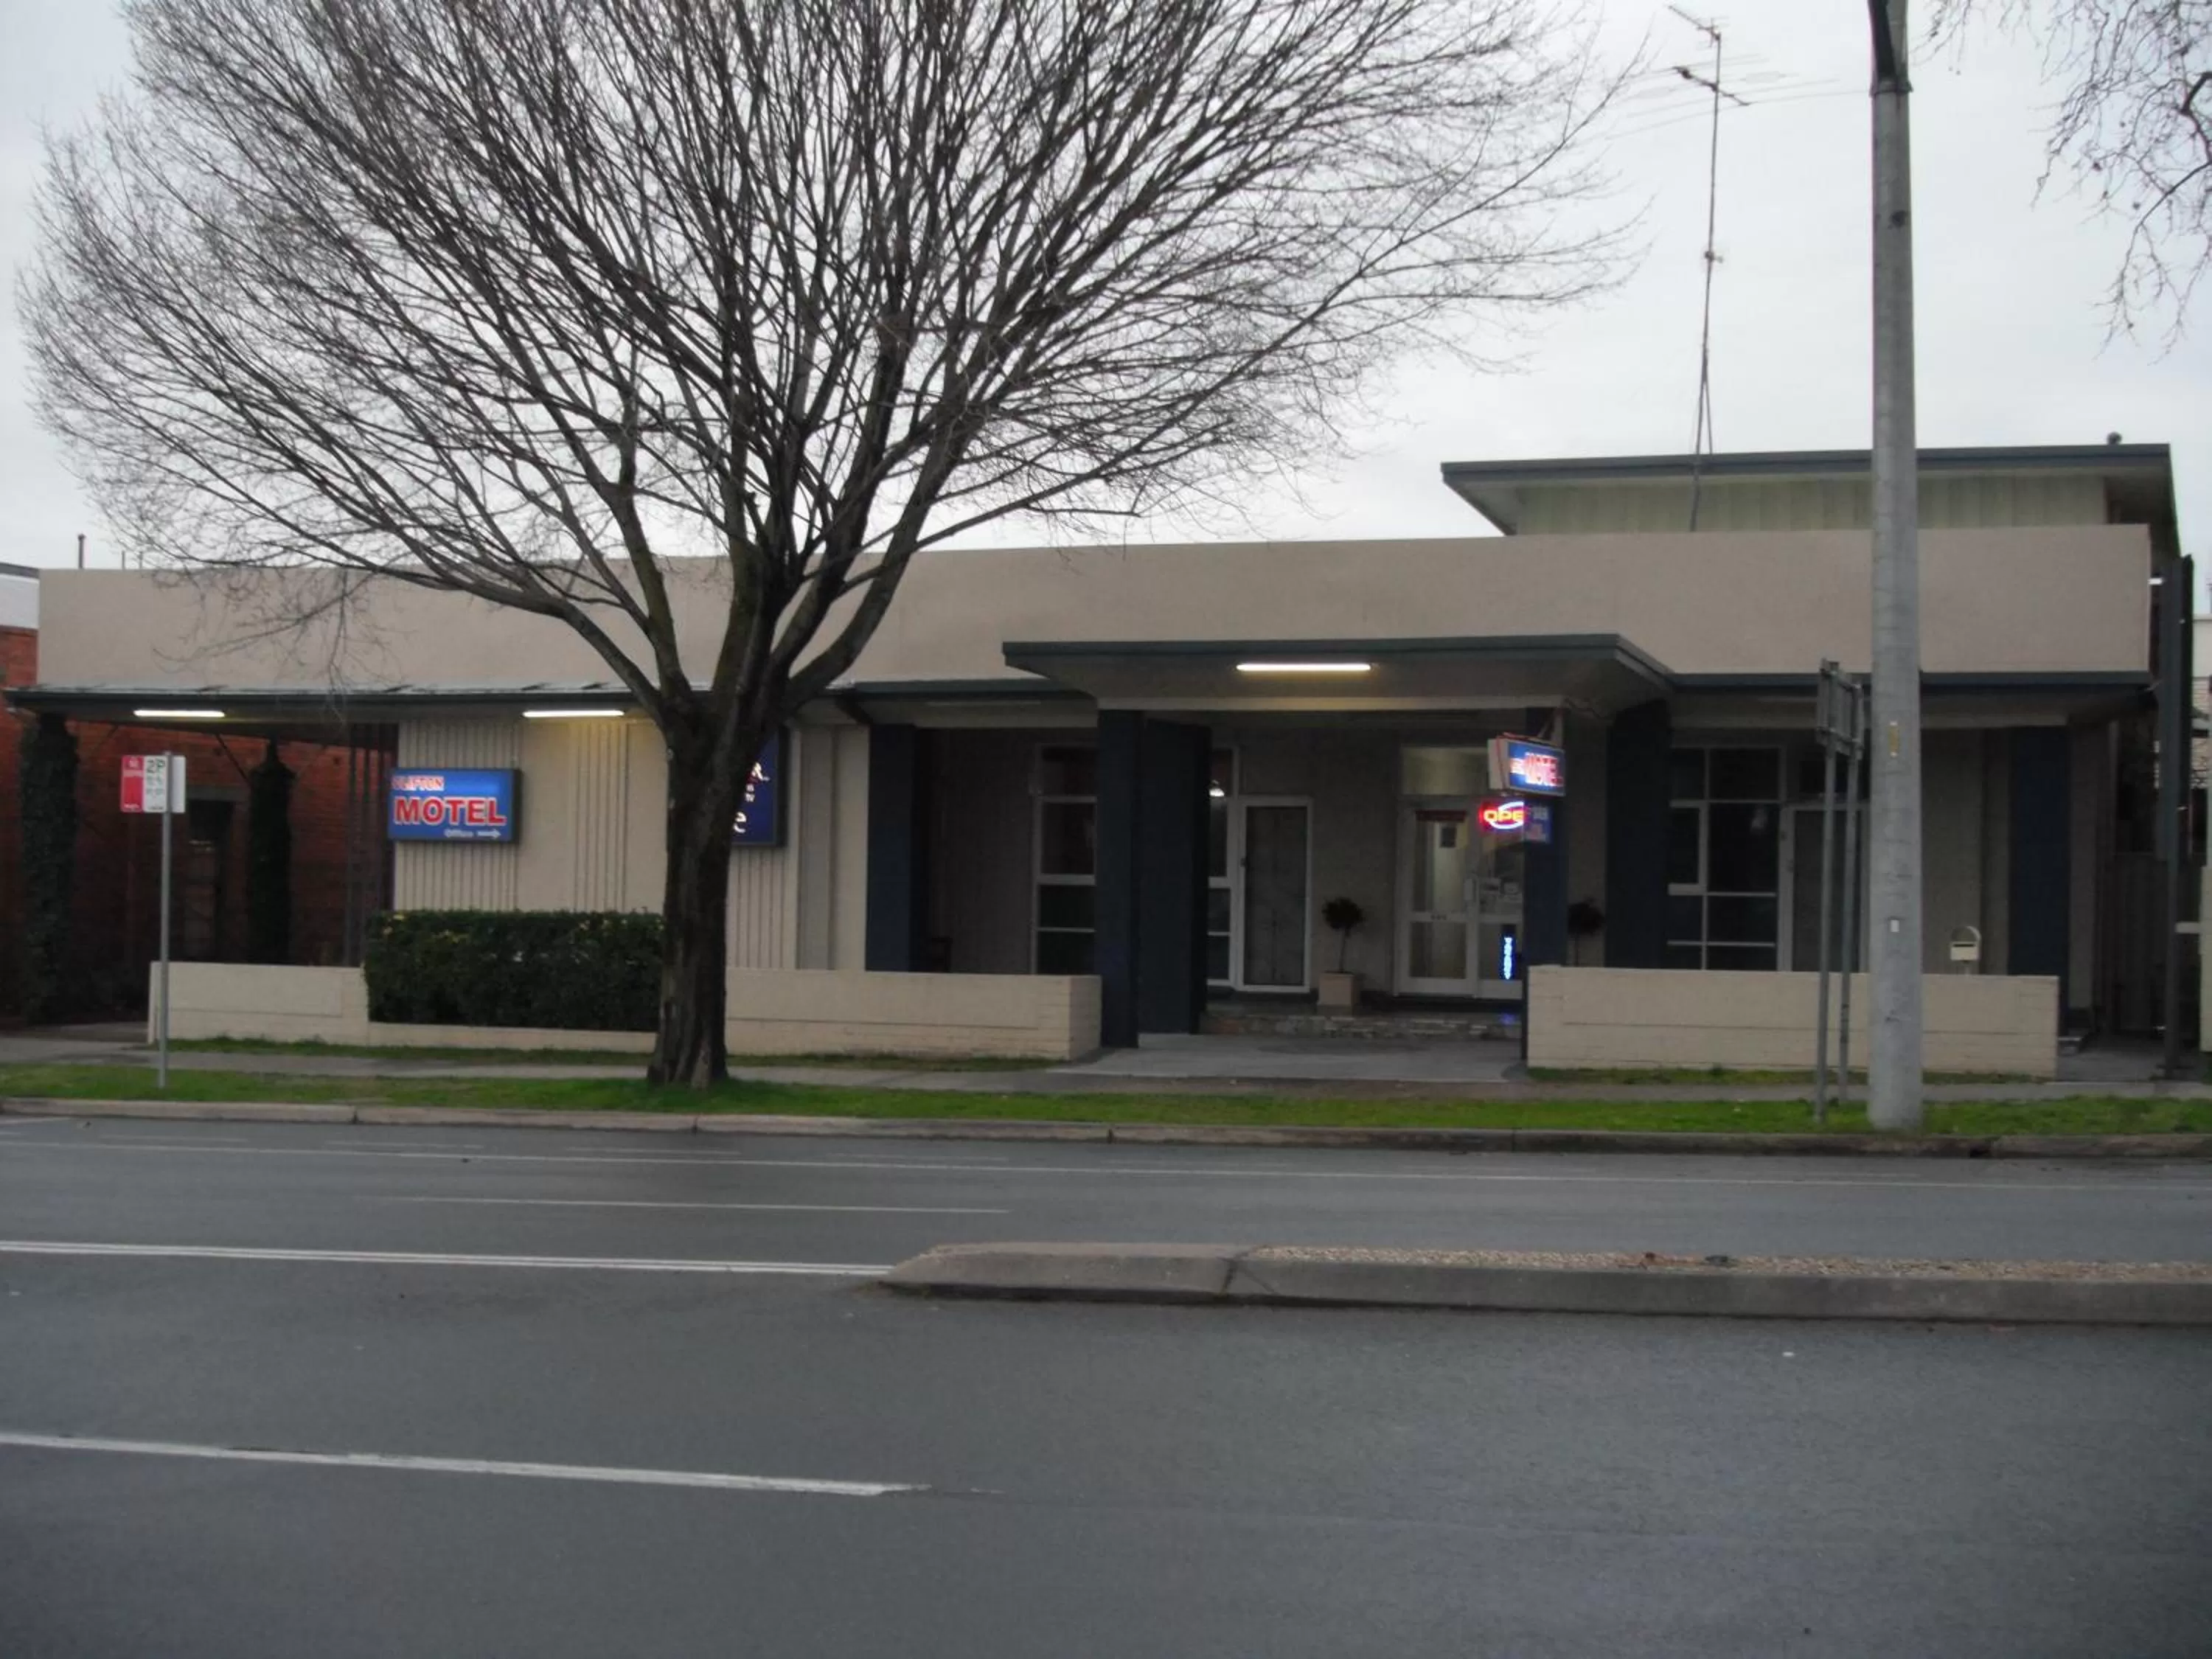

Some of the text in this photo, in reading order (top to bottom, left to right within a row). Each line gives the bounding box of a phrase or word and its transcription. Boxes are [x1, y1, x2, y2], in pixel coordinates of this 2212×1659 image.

[146, 759, 166, 773] 2P
[394, 796, 507, 825] MOTEL
[1484, 810, 1524, 822] OPE
